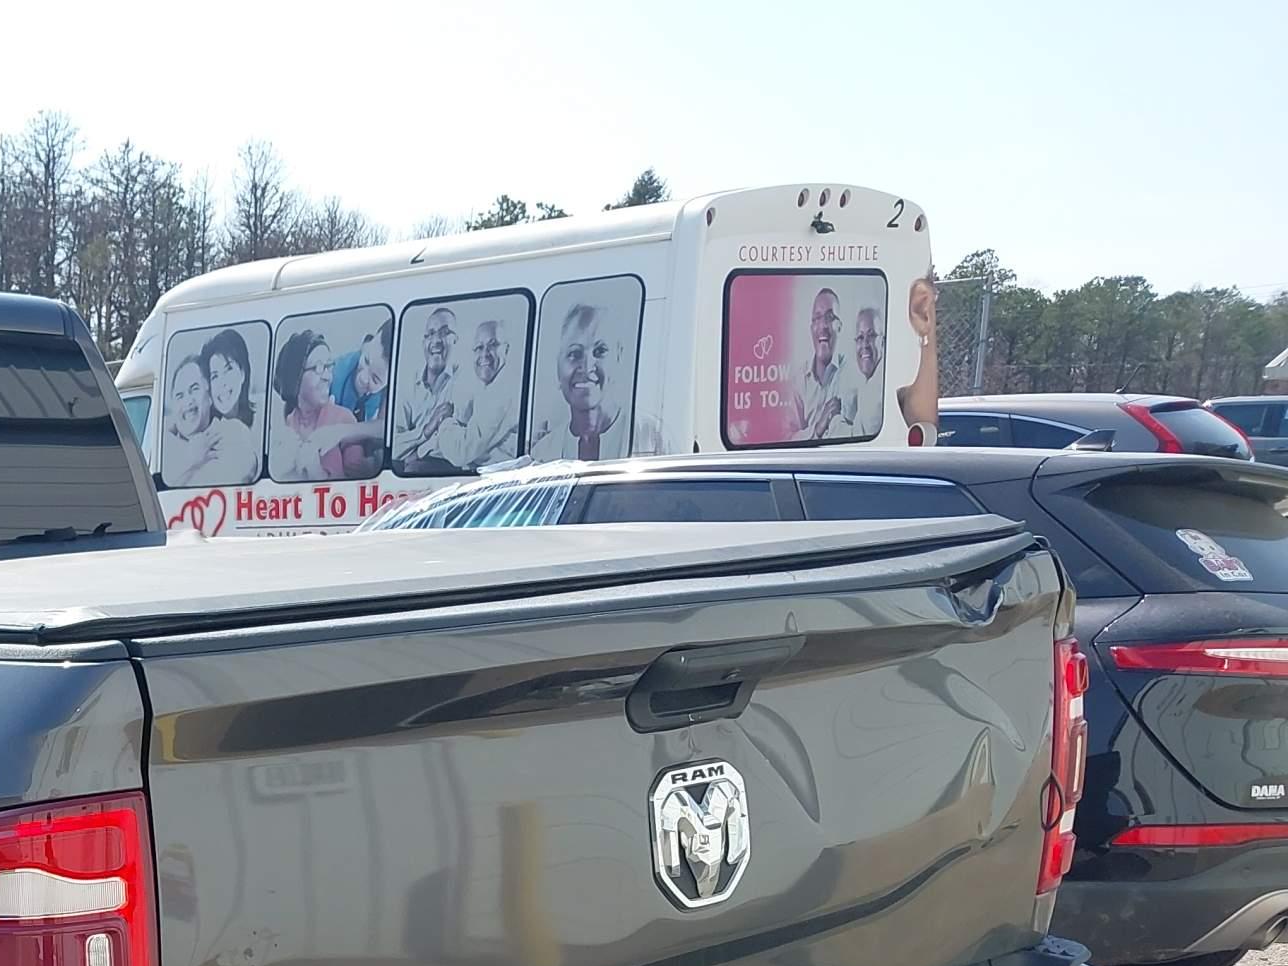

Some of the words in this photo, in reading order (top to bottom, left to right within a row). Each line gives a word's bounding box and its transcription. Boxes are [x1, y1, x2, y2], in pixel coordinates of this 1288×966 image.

[886, 199, 905, 228] 2
[738, 245, 813, 262] COURTESY
[820, 245, 879, 261] SHUTTLE
[734, 364, 791, 384] FOLLOW
[734, 391, 751, 409] US
[760, 390, 792, 408] TO...
[235, 489, 303, 522] Heart
[313, 487, 346, 519] To
[670, 764, 726, 785] RAM
